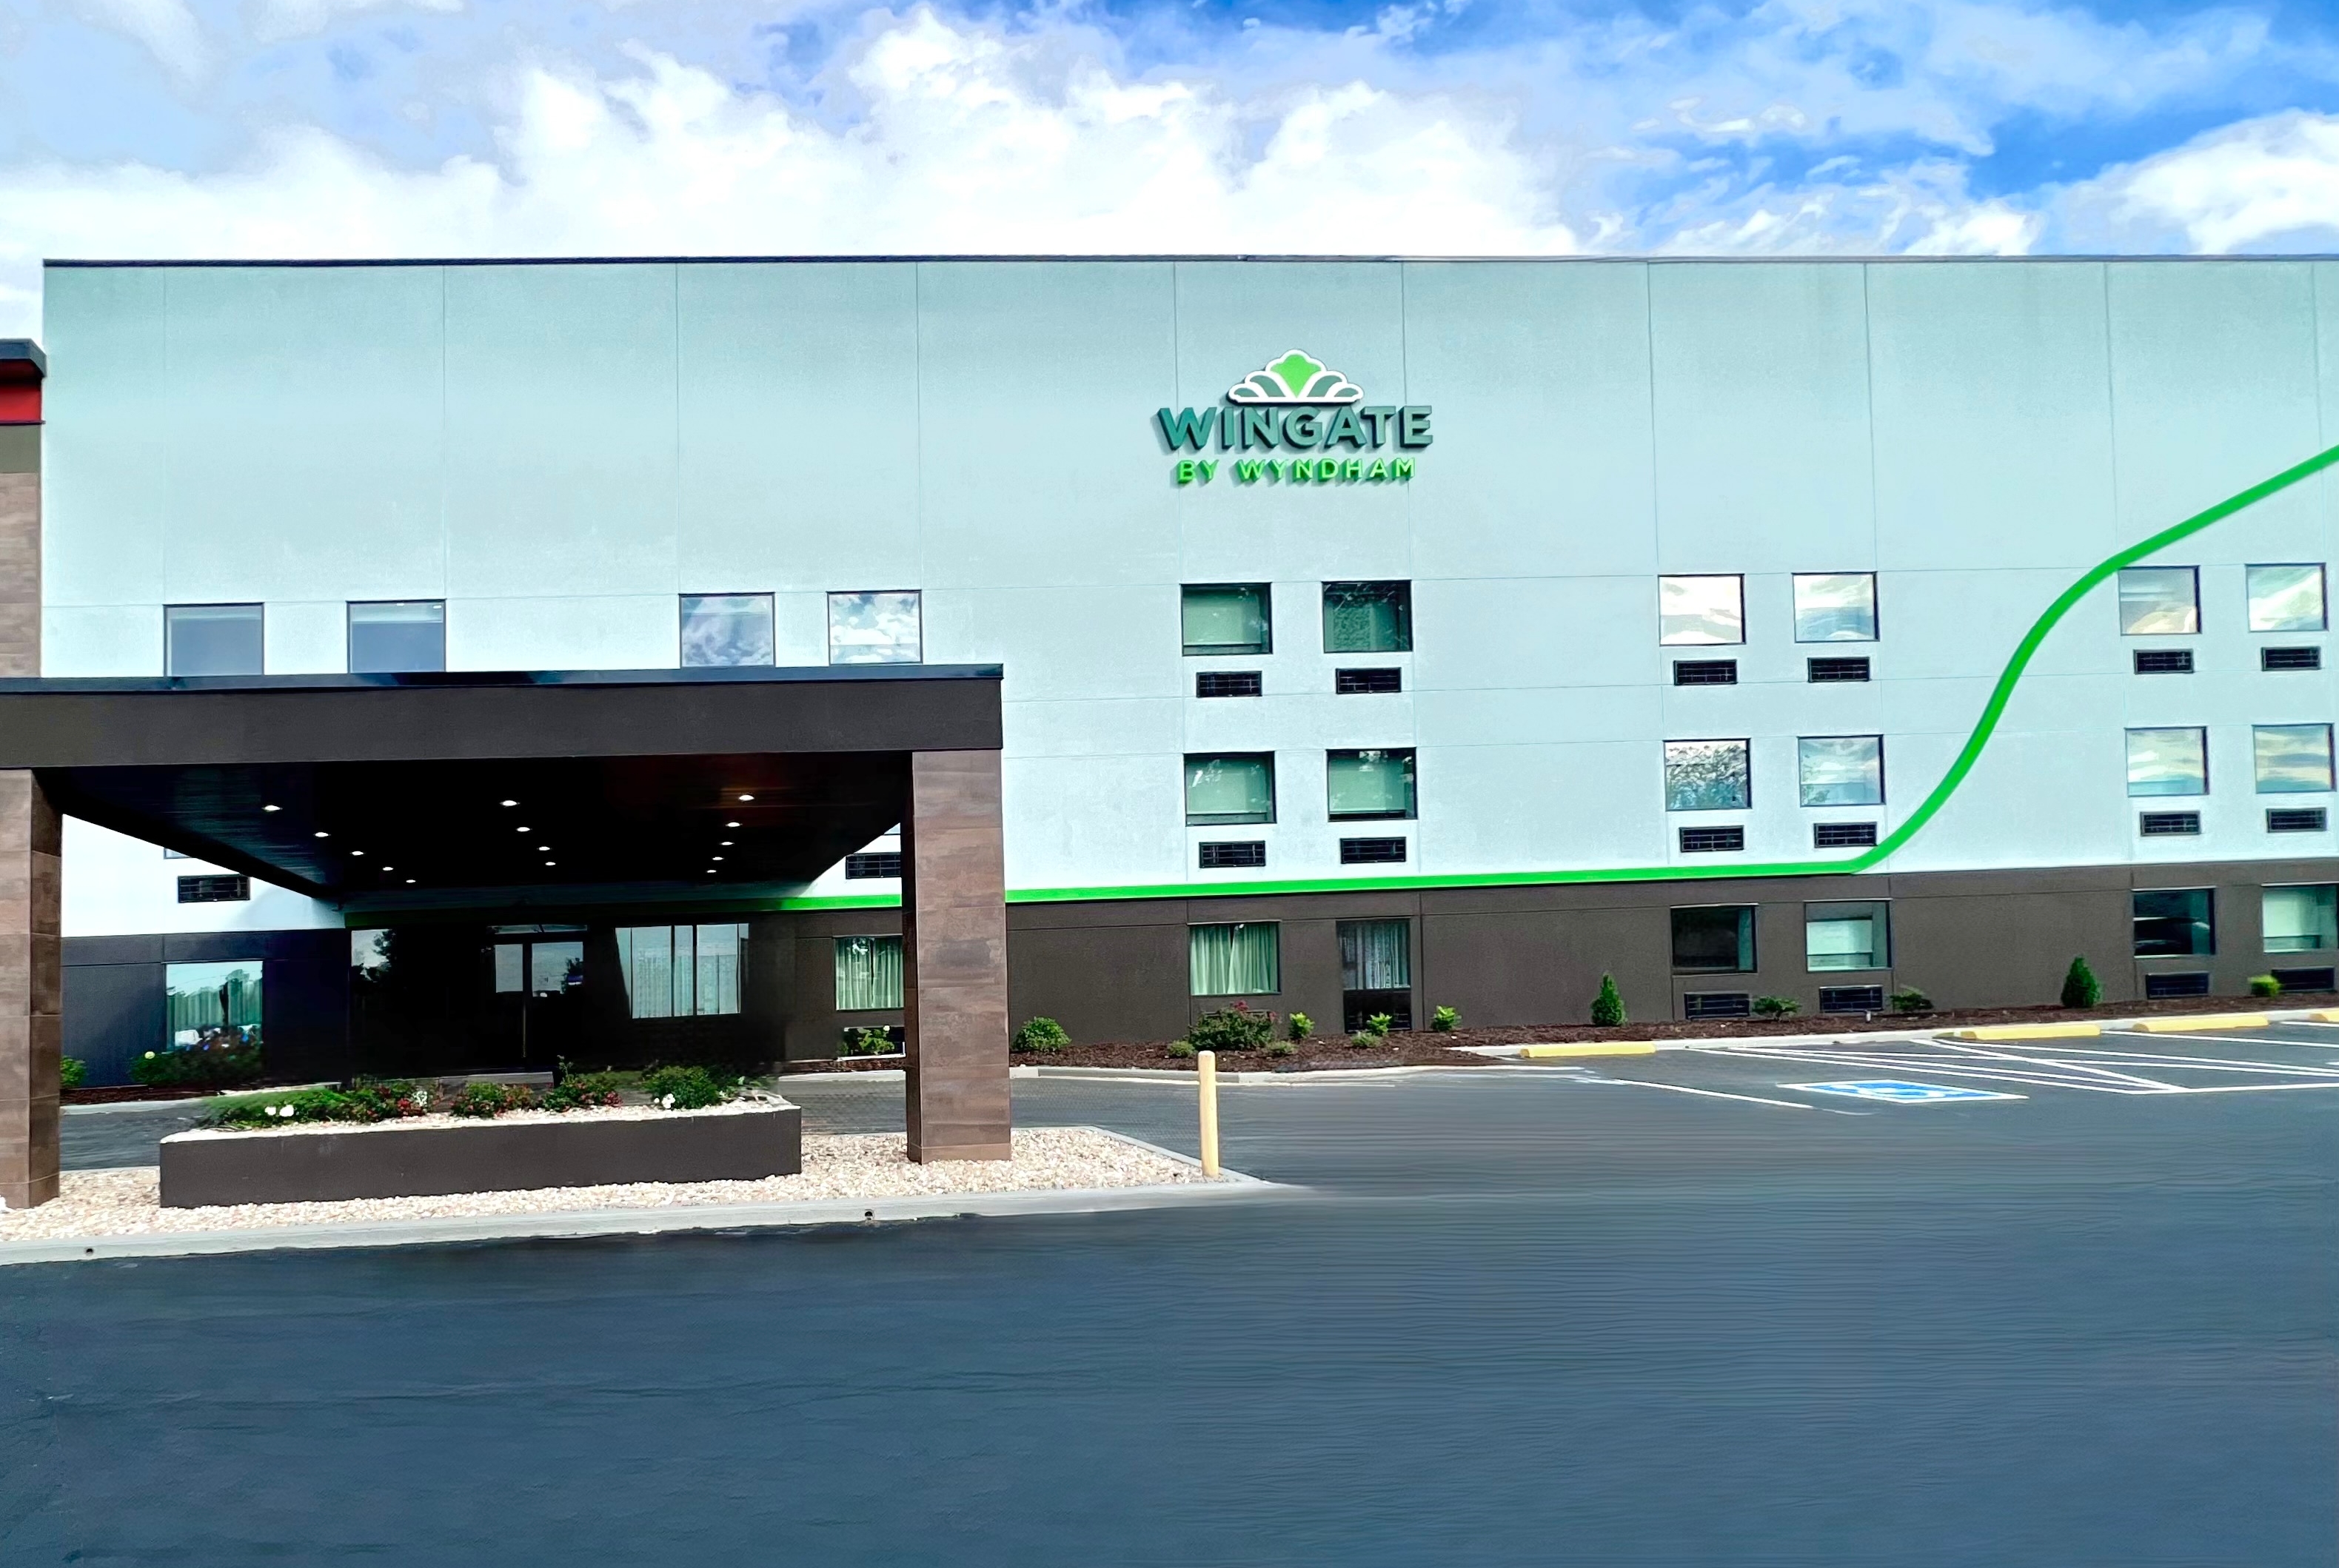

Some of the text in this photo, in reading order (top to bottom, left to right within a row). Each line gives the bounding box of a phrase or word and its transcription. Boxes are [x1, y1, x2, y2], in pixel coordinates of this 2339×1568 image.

[1157, 405, 1433, 449] WINGATE
[1177, 457, 1416, 483] BY WYNDHAM
